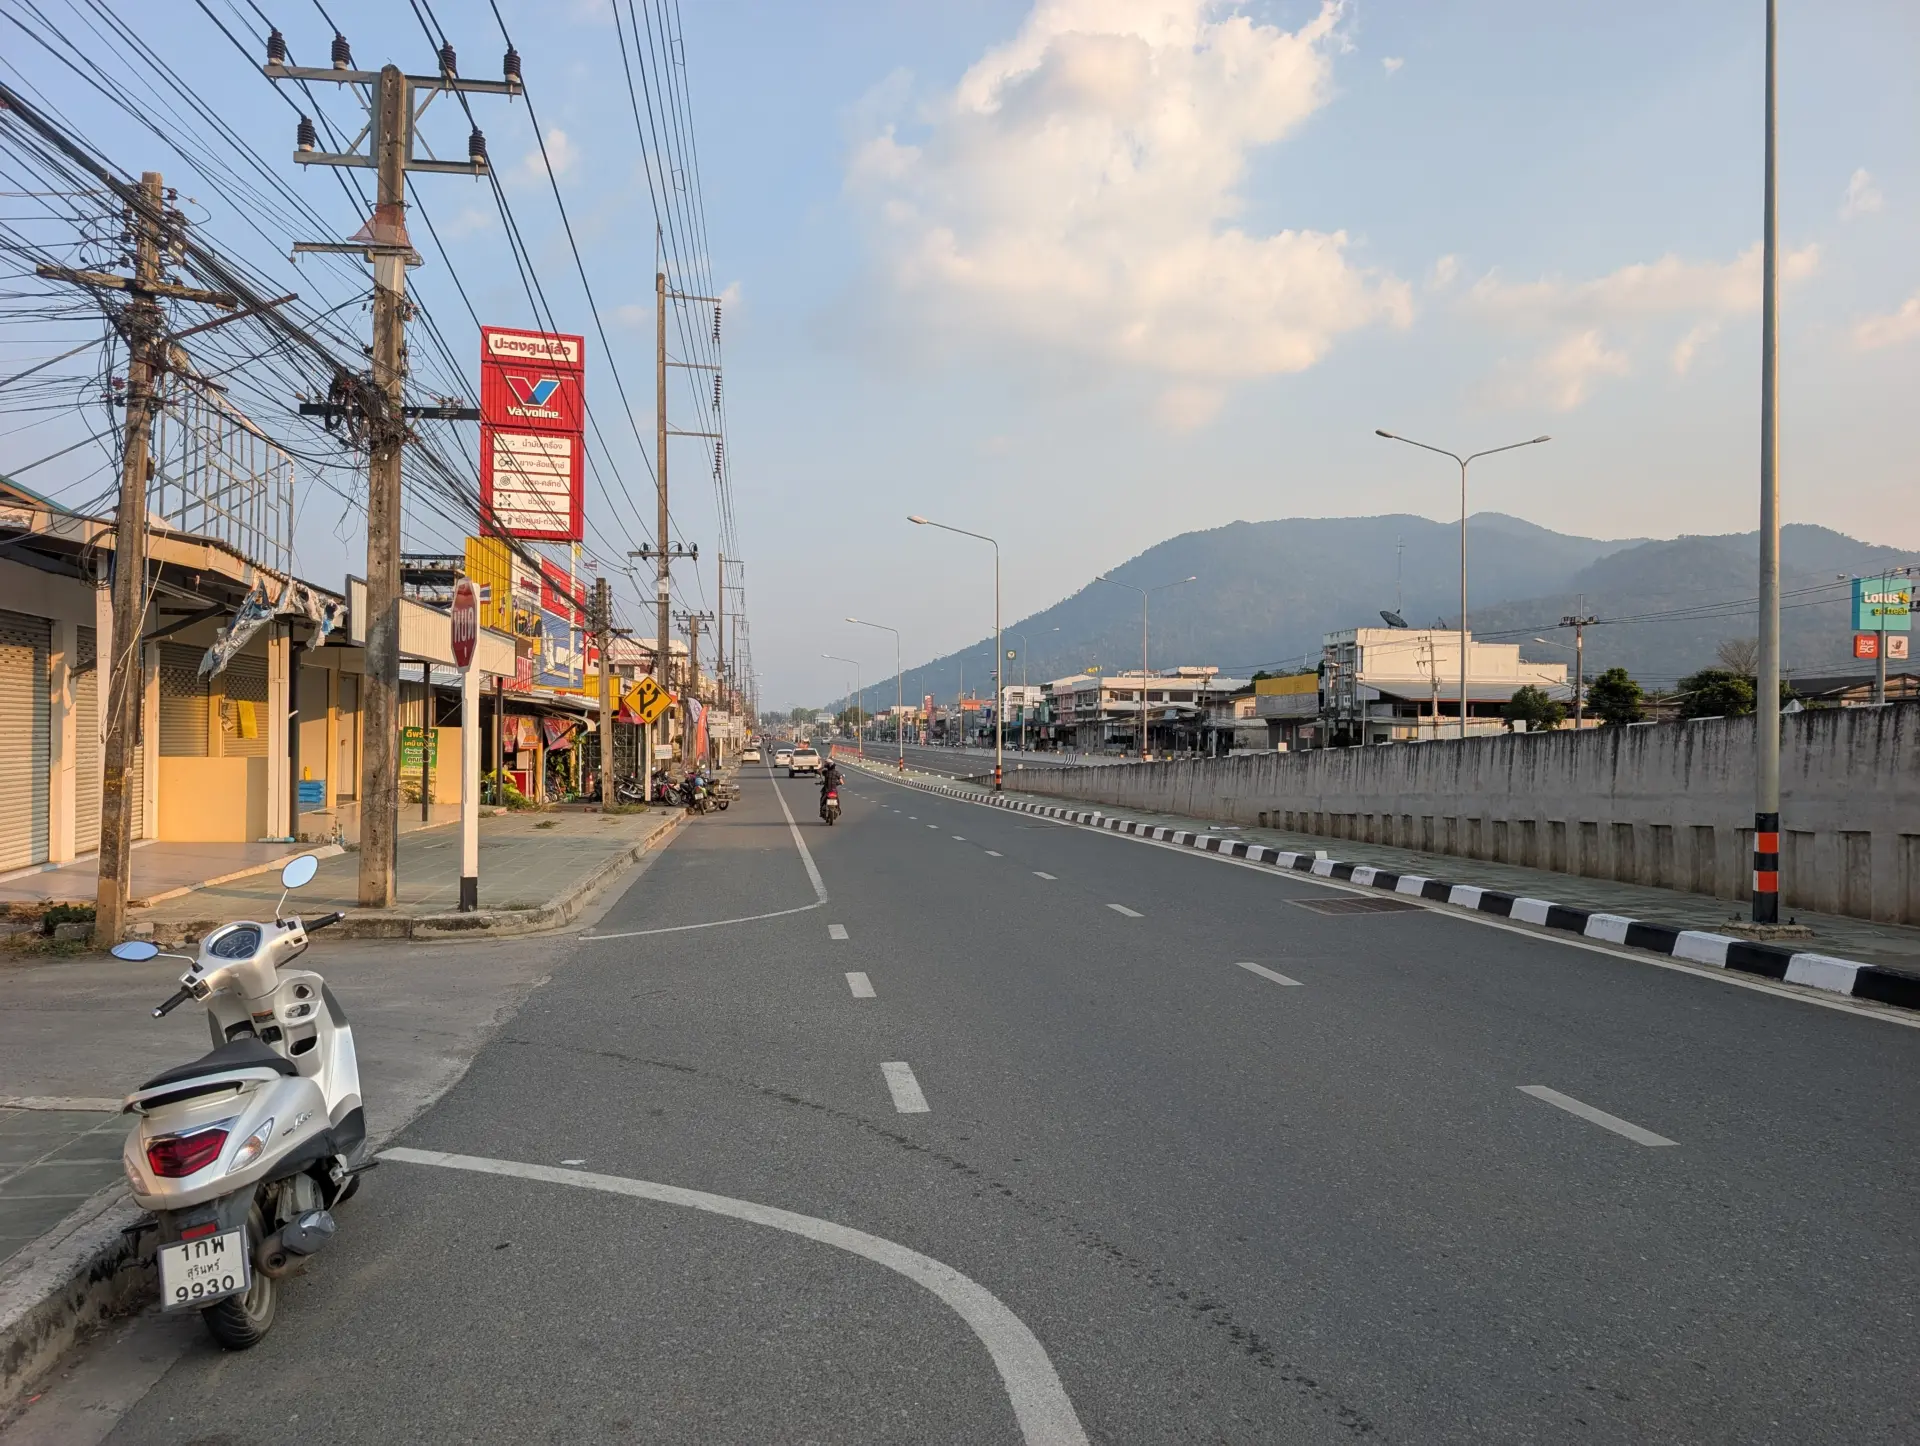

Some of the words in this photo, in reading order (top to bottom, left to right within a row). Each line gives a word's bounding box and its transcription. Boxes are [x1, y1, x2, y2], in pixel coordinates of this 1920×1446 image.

[1864, 591, 1909, 604] Lotus's
[454, 607, 474, 658] หยุด
[187, 1257, 221, 1281] สุรินทร์
[175, 1274, 235, 1303] 9930
